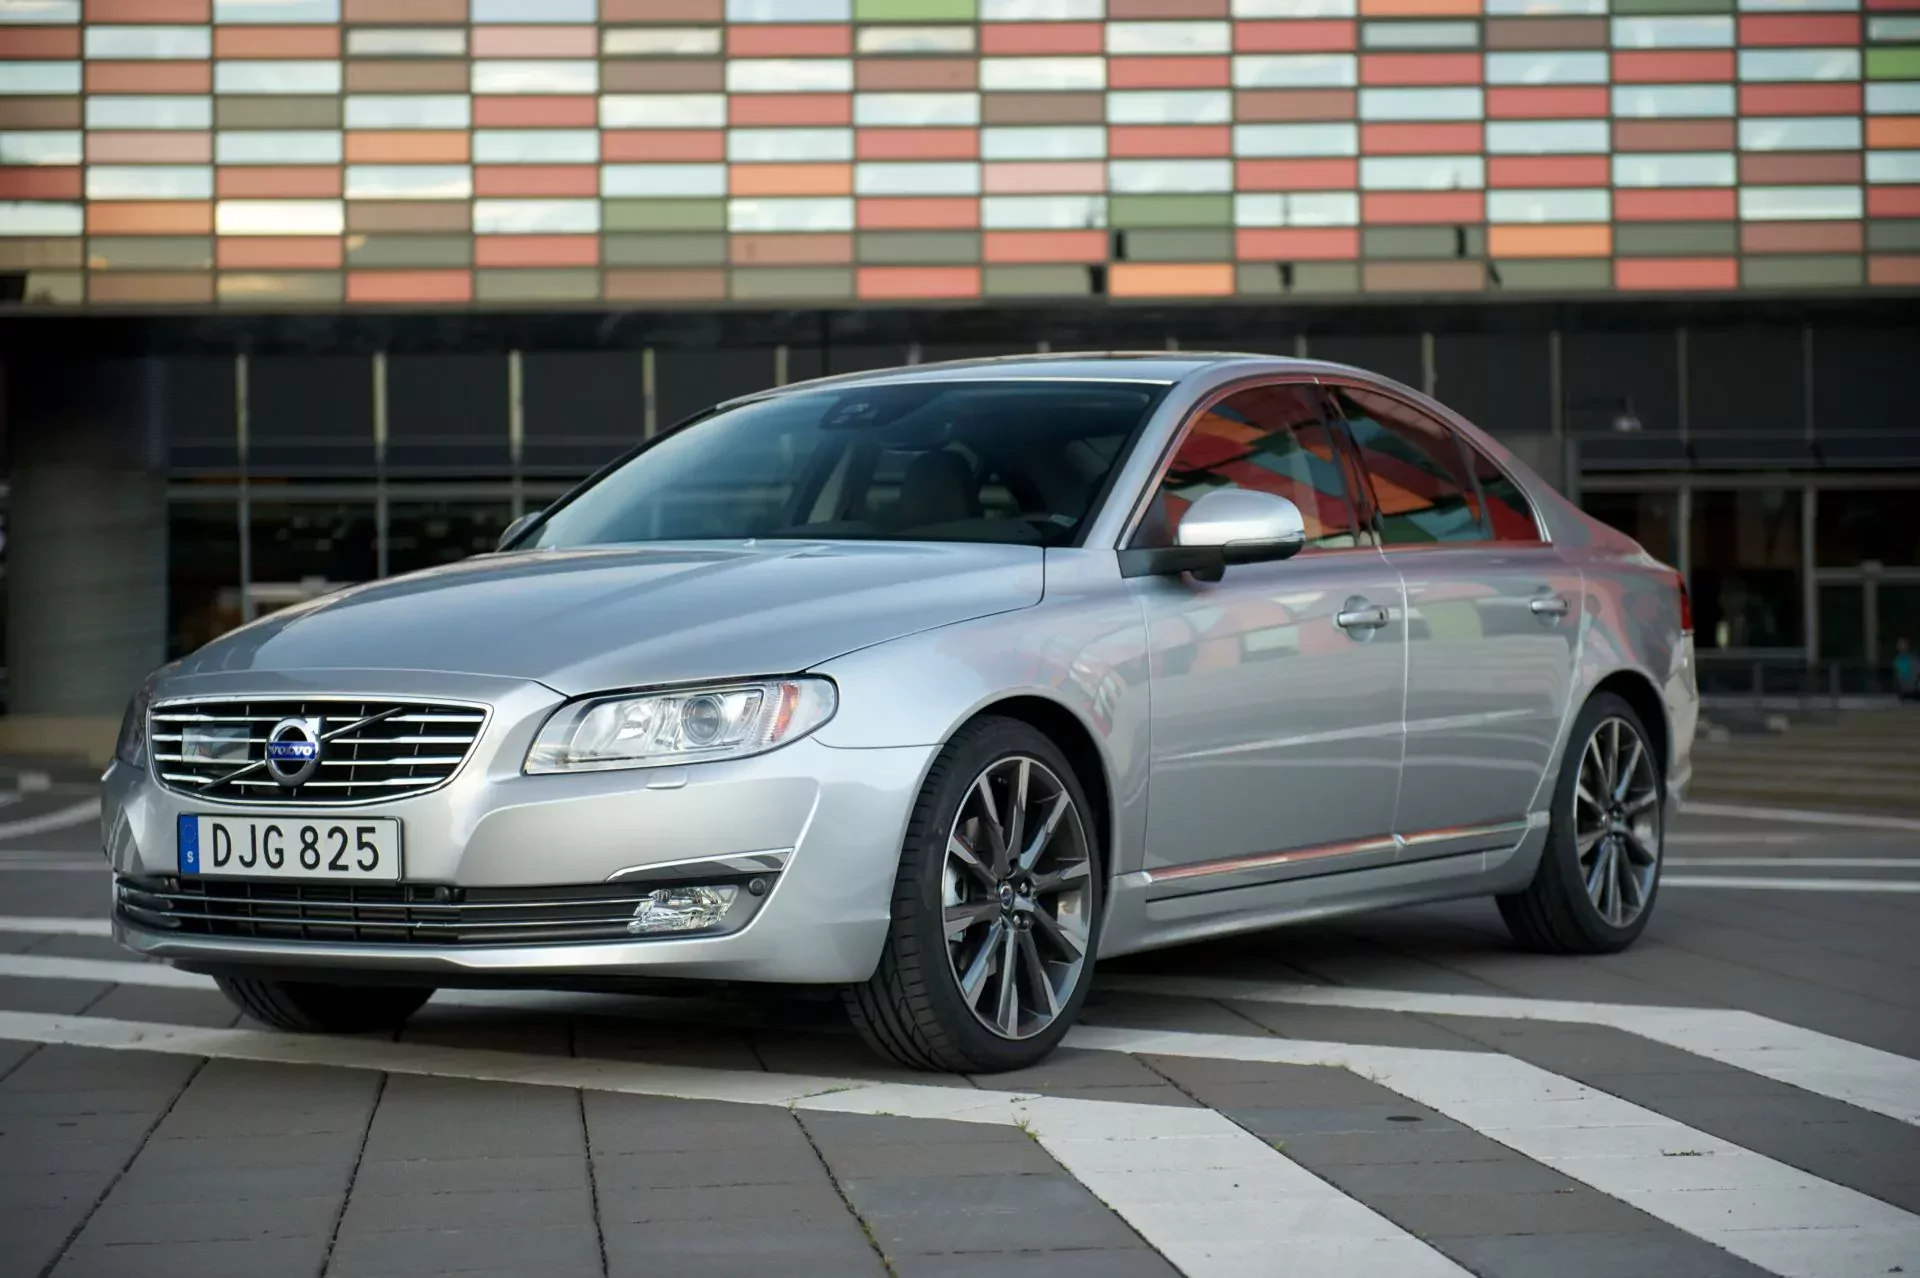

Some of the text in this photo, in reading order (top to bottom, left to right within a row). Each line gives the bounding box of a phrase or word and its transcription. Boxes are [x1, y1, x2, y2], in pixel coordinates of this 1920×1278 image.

[268, 745, 313, 756] VOLVO
[212, 823, 380, 872] DJG 825
[186, 851, 194, 863] S
